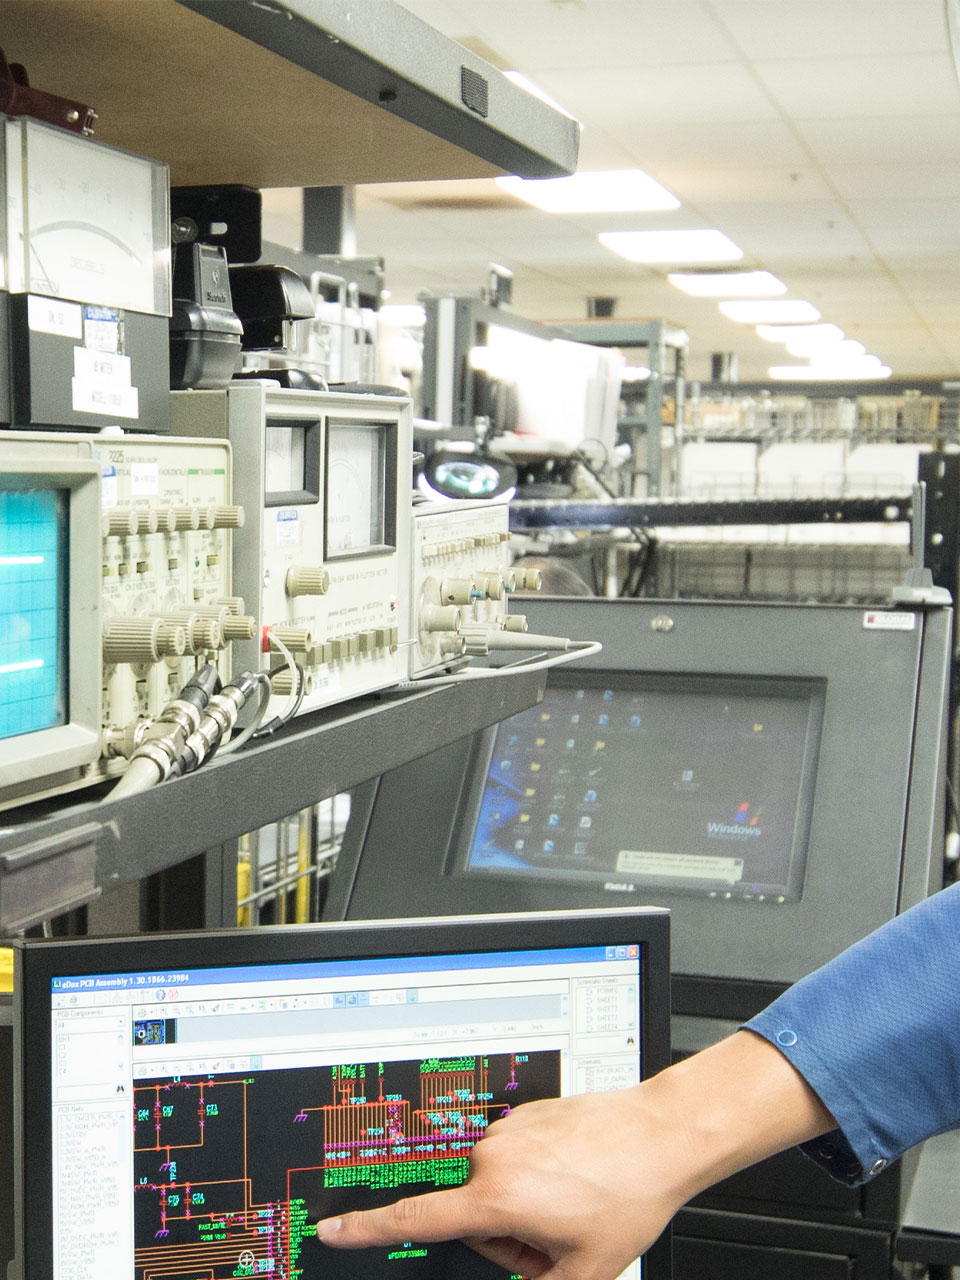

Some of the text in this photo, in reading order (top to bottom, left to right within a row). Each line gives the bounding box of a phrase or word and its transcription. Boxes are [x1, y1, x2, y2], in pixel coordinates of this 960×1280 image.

[708, 821, 761, 836] Windows
[80, 979, 94, 987] PCB
[96, 977, 128, 988] Assembly
